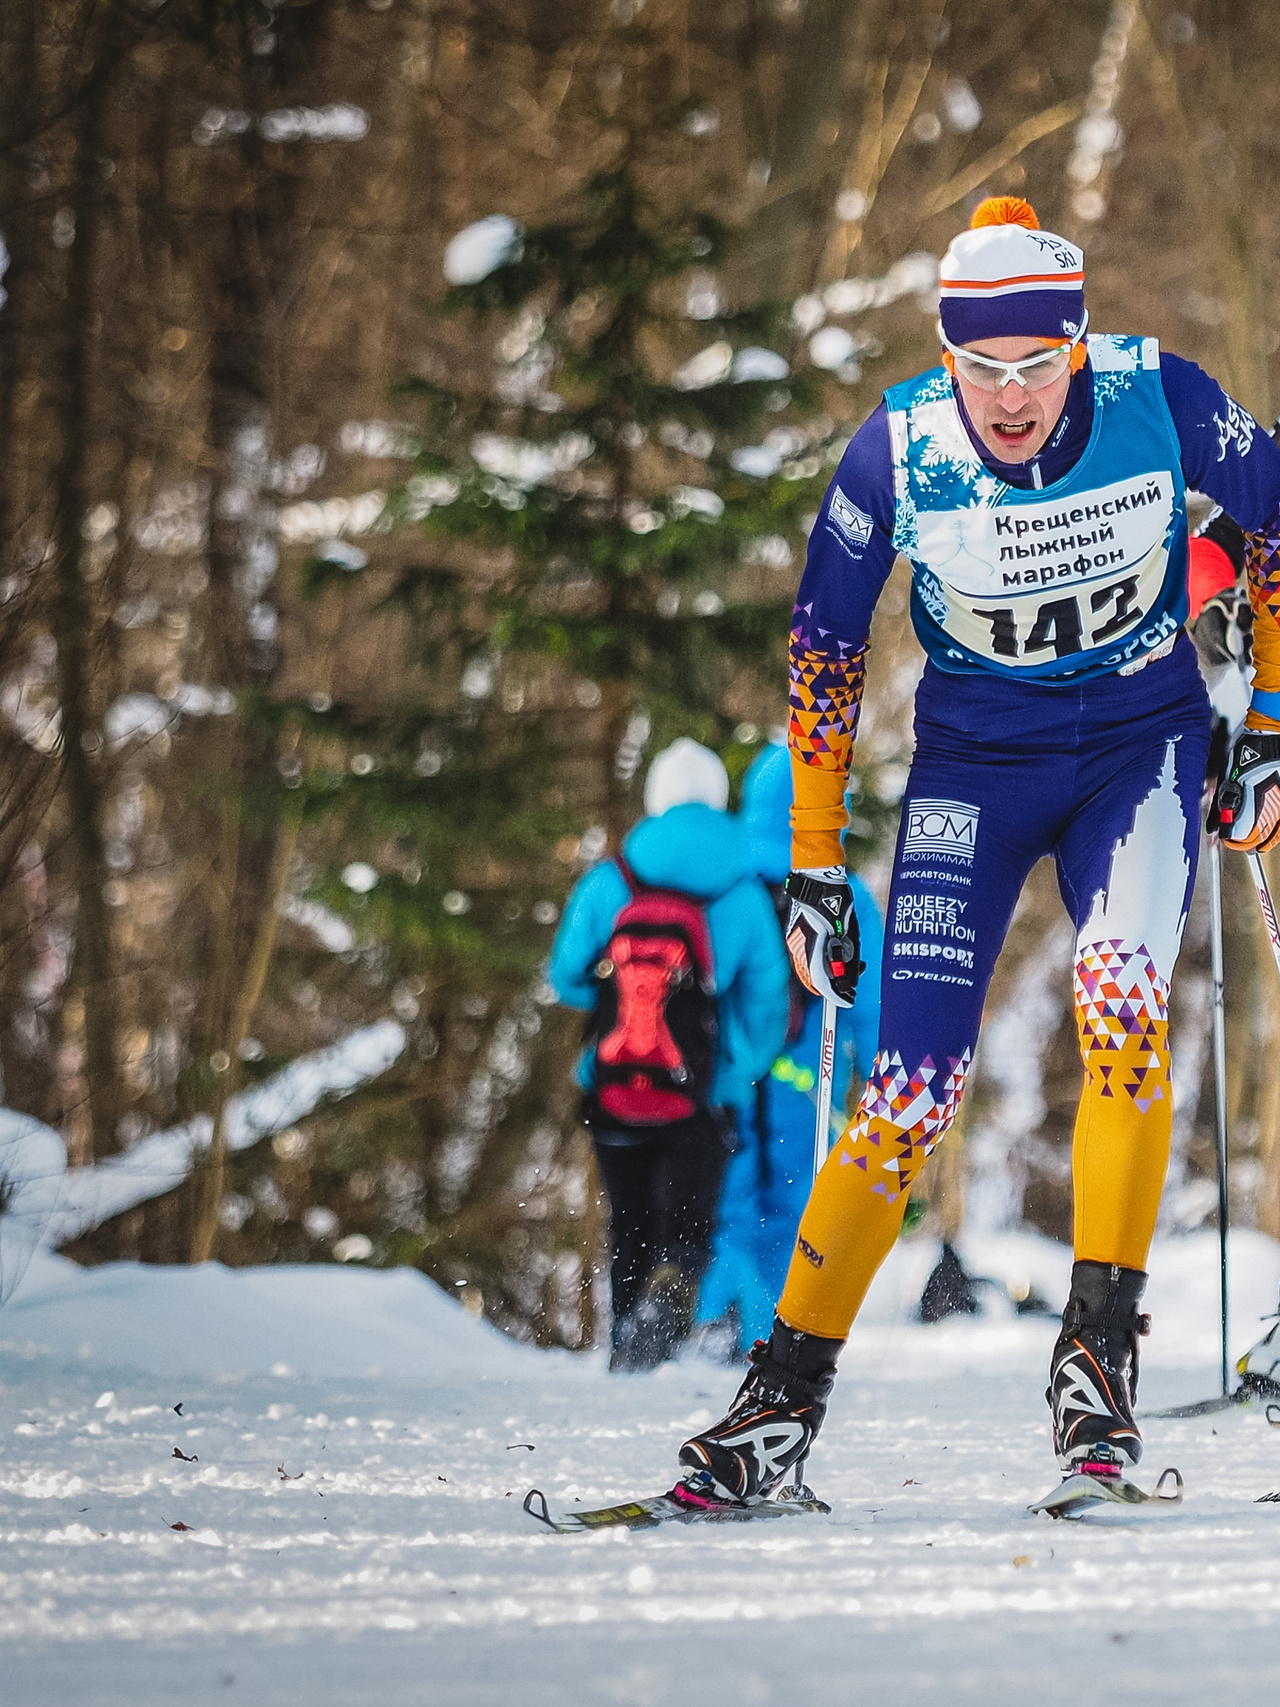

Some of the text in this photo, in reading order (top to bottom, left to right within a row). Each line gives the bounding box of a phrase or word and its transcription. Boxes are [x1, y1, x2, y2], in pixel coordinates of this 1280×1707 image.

[995, 480, 1162, 538] Крещенский
[999, 522, 1115, 561] лыжный
[1002, 548, 1125, 587] марафон
[972, 574, 1144, 658] 142
[896, 908, 957, 925] SPORTS
[897, 894, 968, 914] SQUEEZY
[894, 920, 976, 942] NUTRITION
[914, 971, 974, 987] PELOTON
[822, 1027, 834, 1082] SWIX
